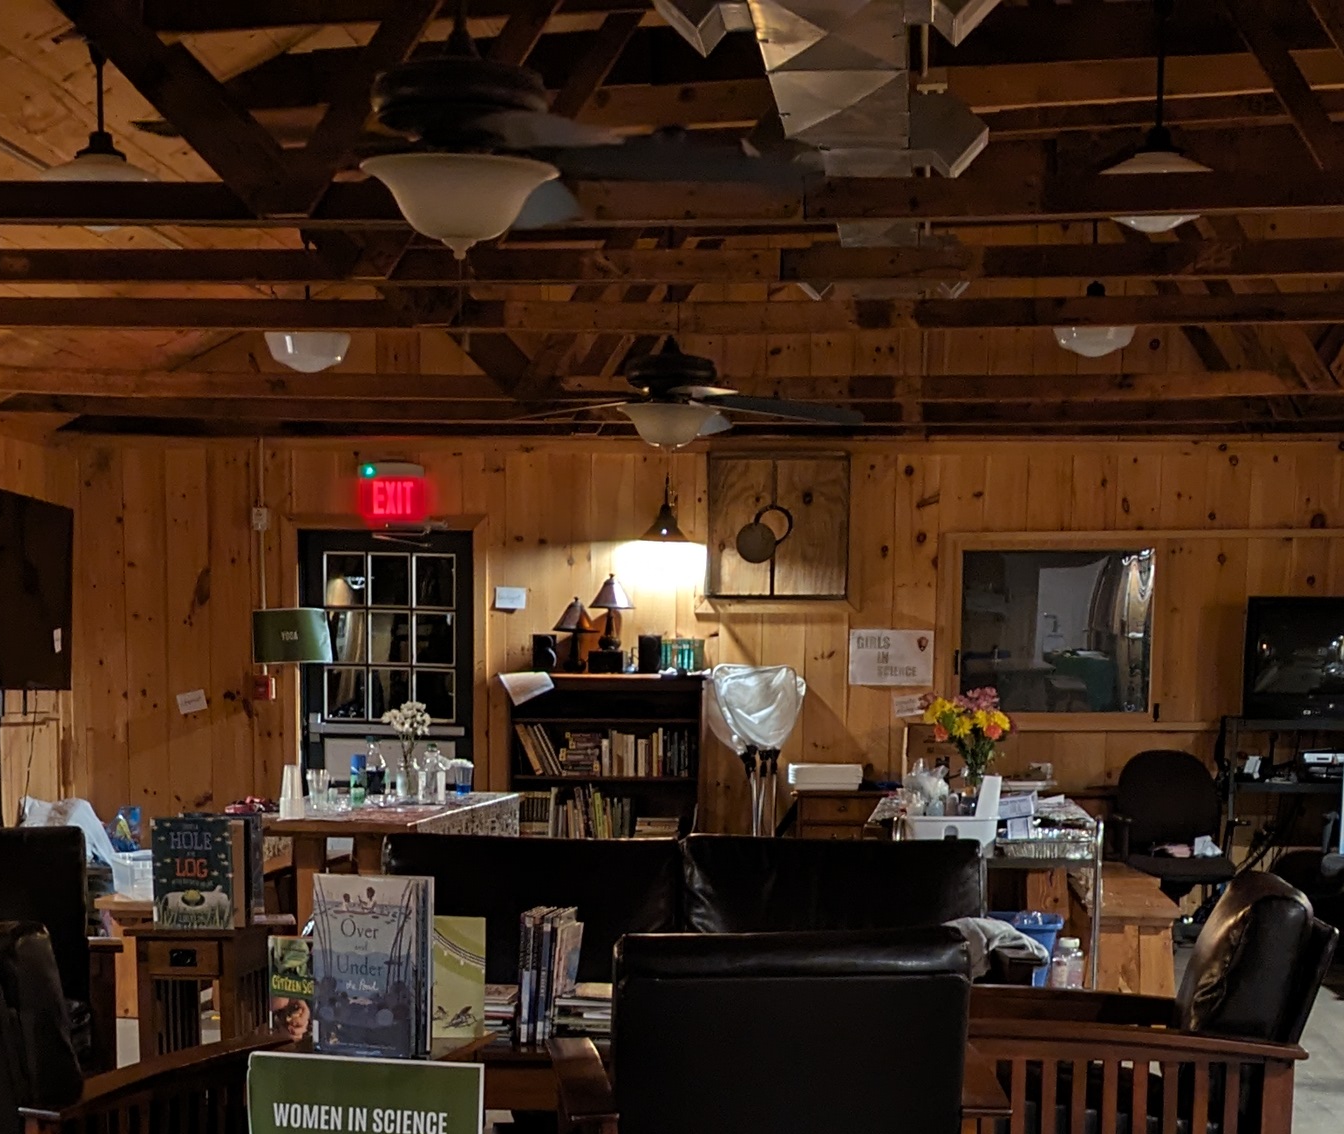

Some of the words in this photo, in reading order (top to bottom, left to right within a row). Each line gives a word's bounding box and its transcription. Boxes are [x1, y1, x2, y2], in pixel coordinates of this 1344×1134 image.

[372, 481, 414, 514] EXIT
[280, 630, 299, 641] YOGA
[856, 635, 891, 649] GIRLS
[877, 651, 889, 664] IN
[877, 666, 917, 677] SCIENCE
[169, 831, 212, 850] HOLE
[175, 858, 208, 878] LOG
[340, 917, 379, 939] Over
[336, 954, 384, 976] Under
[272, 973, 302, 993] CITIZEN
[273, 1102, 342, 1131] WOMEN
[348, 1107, 367, 1132] IN
